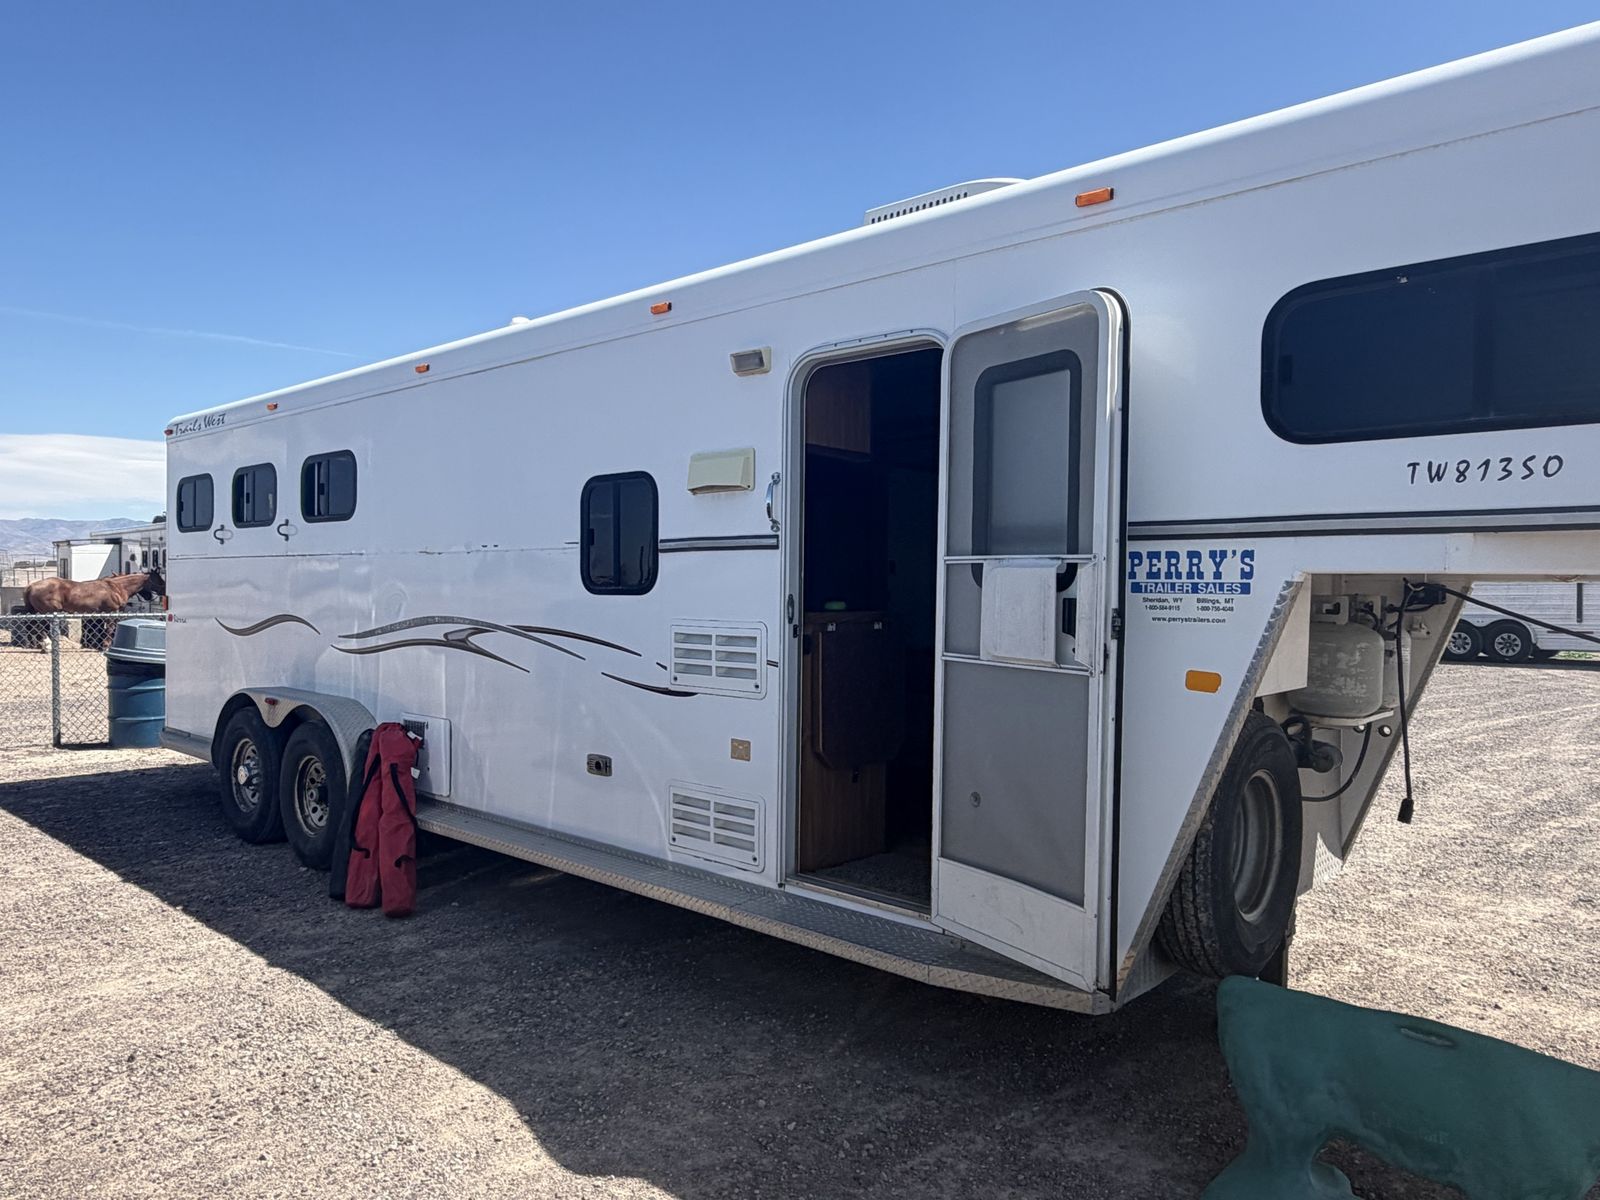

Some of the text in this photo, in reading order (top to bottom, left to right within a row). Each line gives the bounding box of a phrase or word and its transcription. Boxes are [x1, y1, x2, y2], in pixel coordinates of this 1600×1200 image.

[174, 413, 227, 436] Trails West
[1128, 549, 1255, 580] PERRY'S
[1140, 582, 1241, 594] TRAILER SALES
[1152, 616, 1226, 624] www.perrystrailers.com
